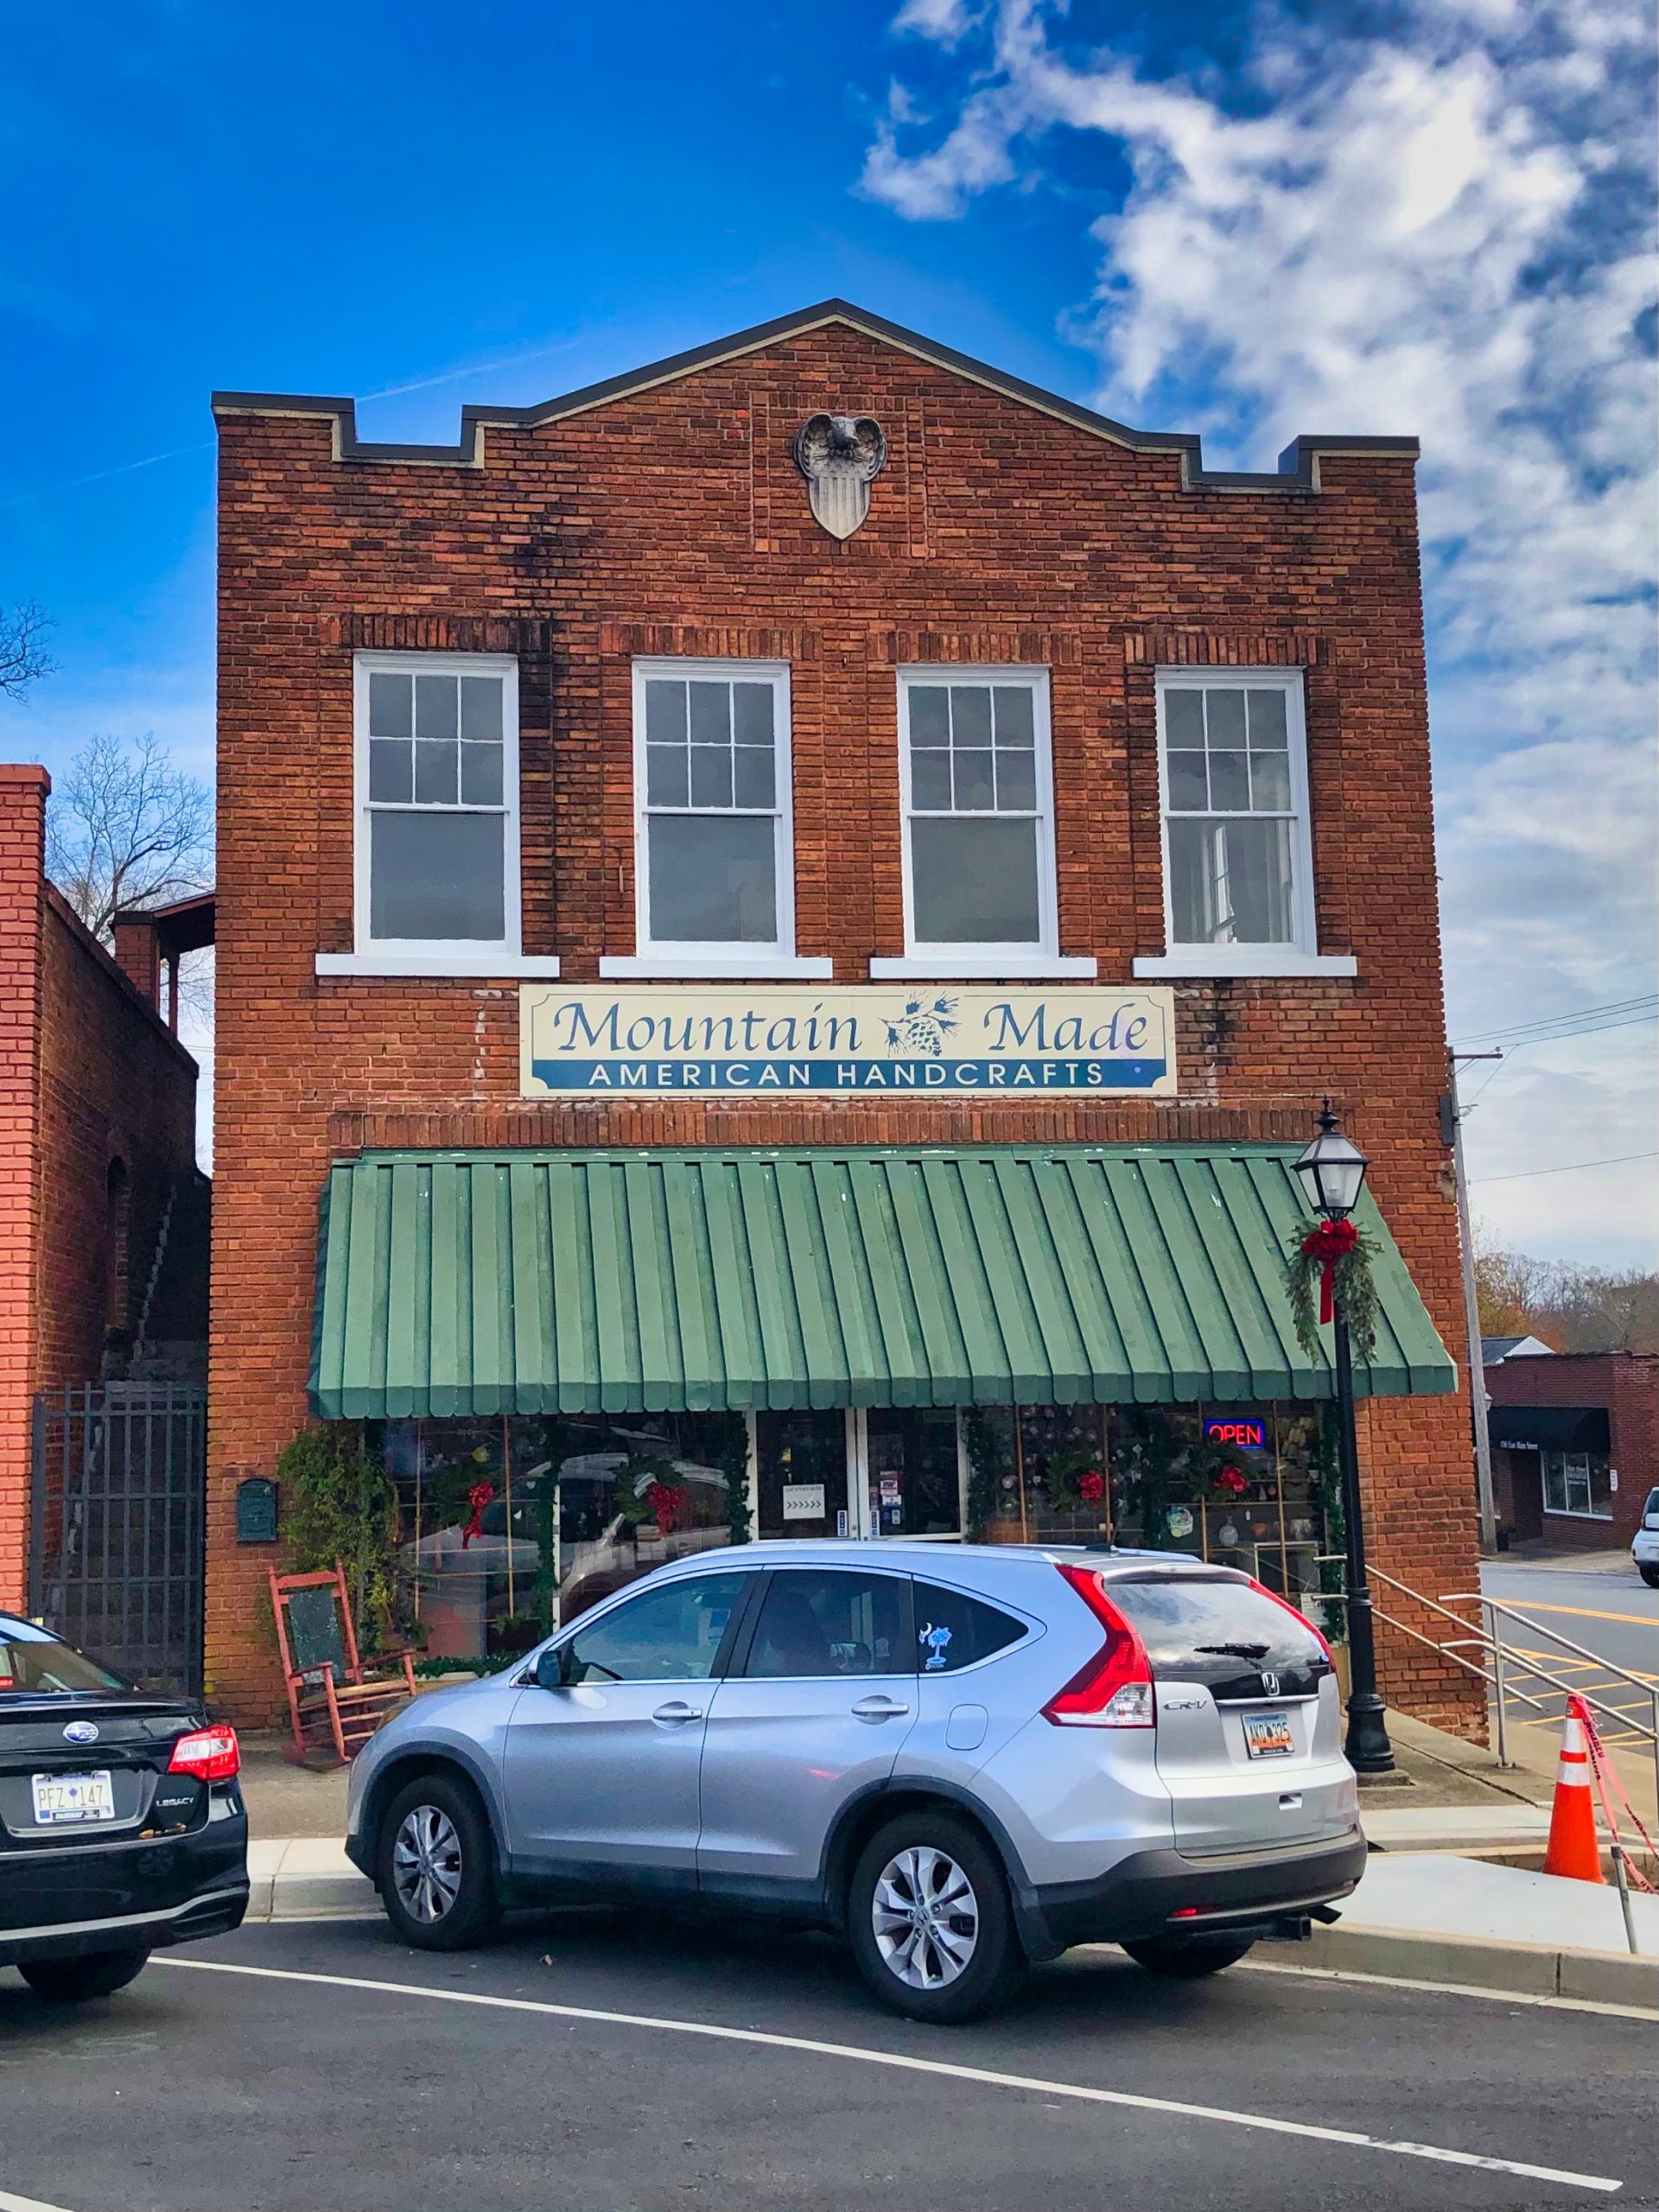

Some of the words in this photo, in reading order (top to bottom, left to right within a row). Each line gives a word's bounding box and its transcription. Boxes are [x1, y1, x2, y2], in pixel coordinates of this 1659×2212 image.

[553, 1001, 863, 1052] Mountain
[983, 1002, 1147, 1052] Made
[588, 1064, 810, 1086] AMERICAN
[837, 1063, 1103, 1086] HANDCRAFTS
[1209, 1424, 1262, 1446] OPEN
[1272, 1722, 1291, 1742] 325
[38, 1787, 65, 1808] PFZ
[79, 1784, 103, 1807] 147
[156, 1797, 194, 1807] LEGACY
